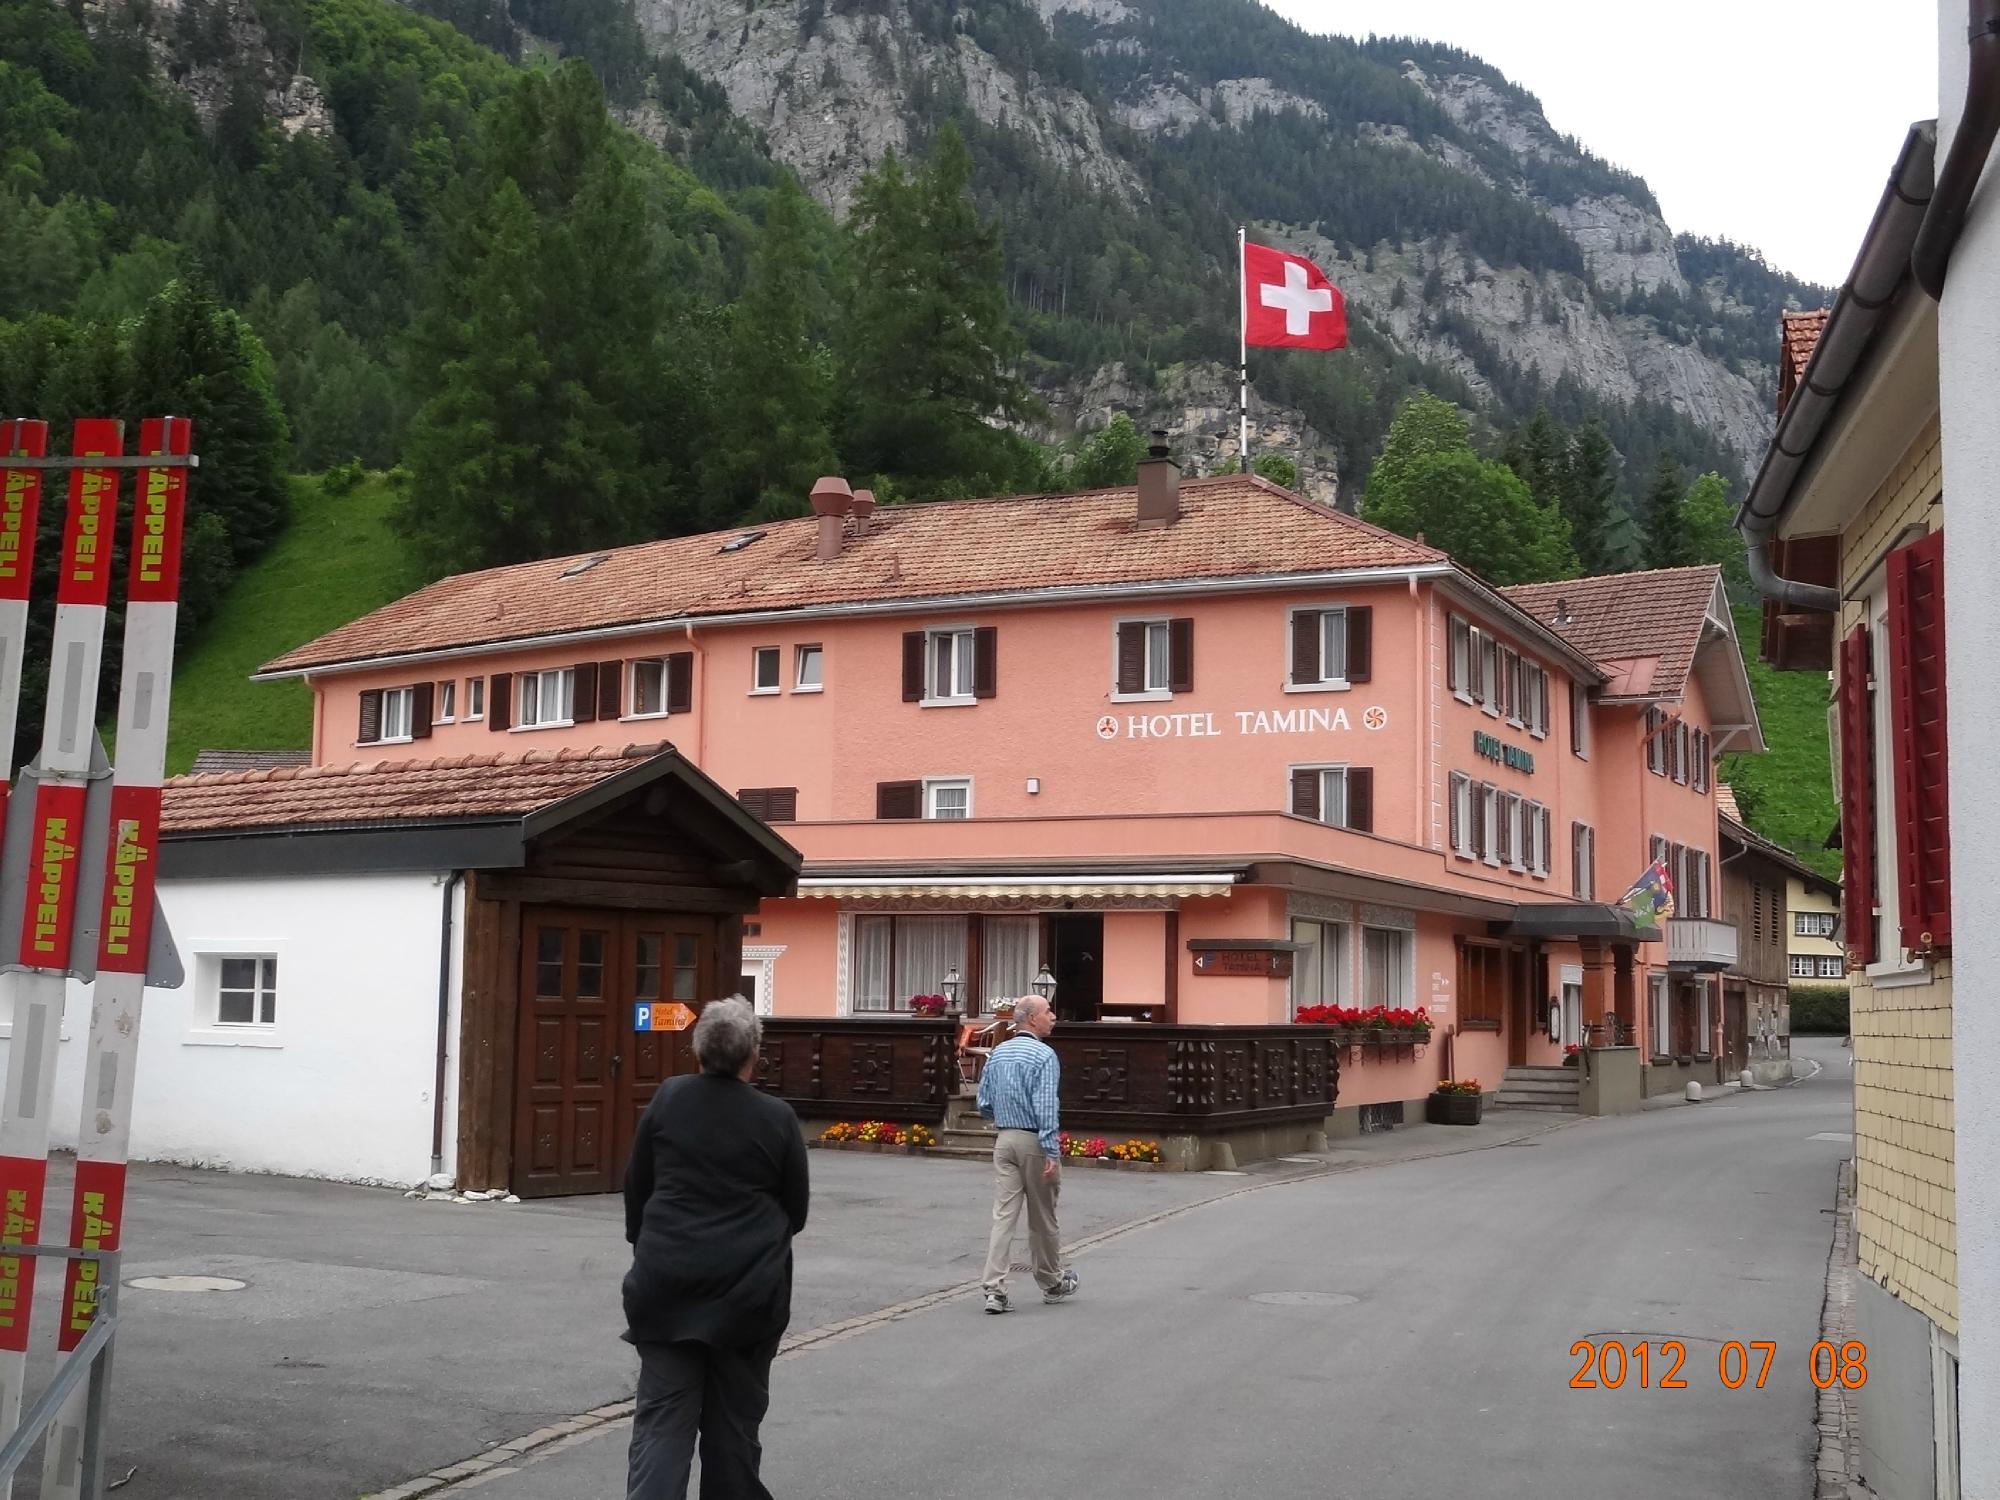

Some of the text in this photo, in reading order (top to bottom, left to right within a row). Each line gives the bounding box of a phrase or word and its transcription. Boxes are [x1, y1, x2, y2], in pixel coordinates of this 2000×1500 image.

[0, 449, 36, 577] ÄPPELI
[1127, 707, 1352, 739] HOTEL TAMINA
[34, 818, 75, 951] KÄPPELI
[107, 819, 148, 954] KÄPPELI
[638, 1007, 649, 1027] P
